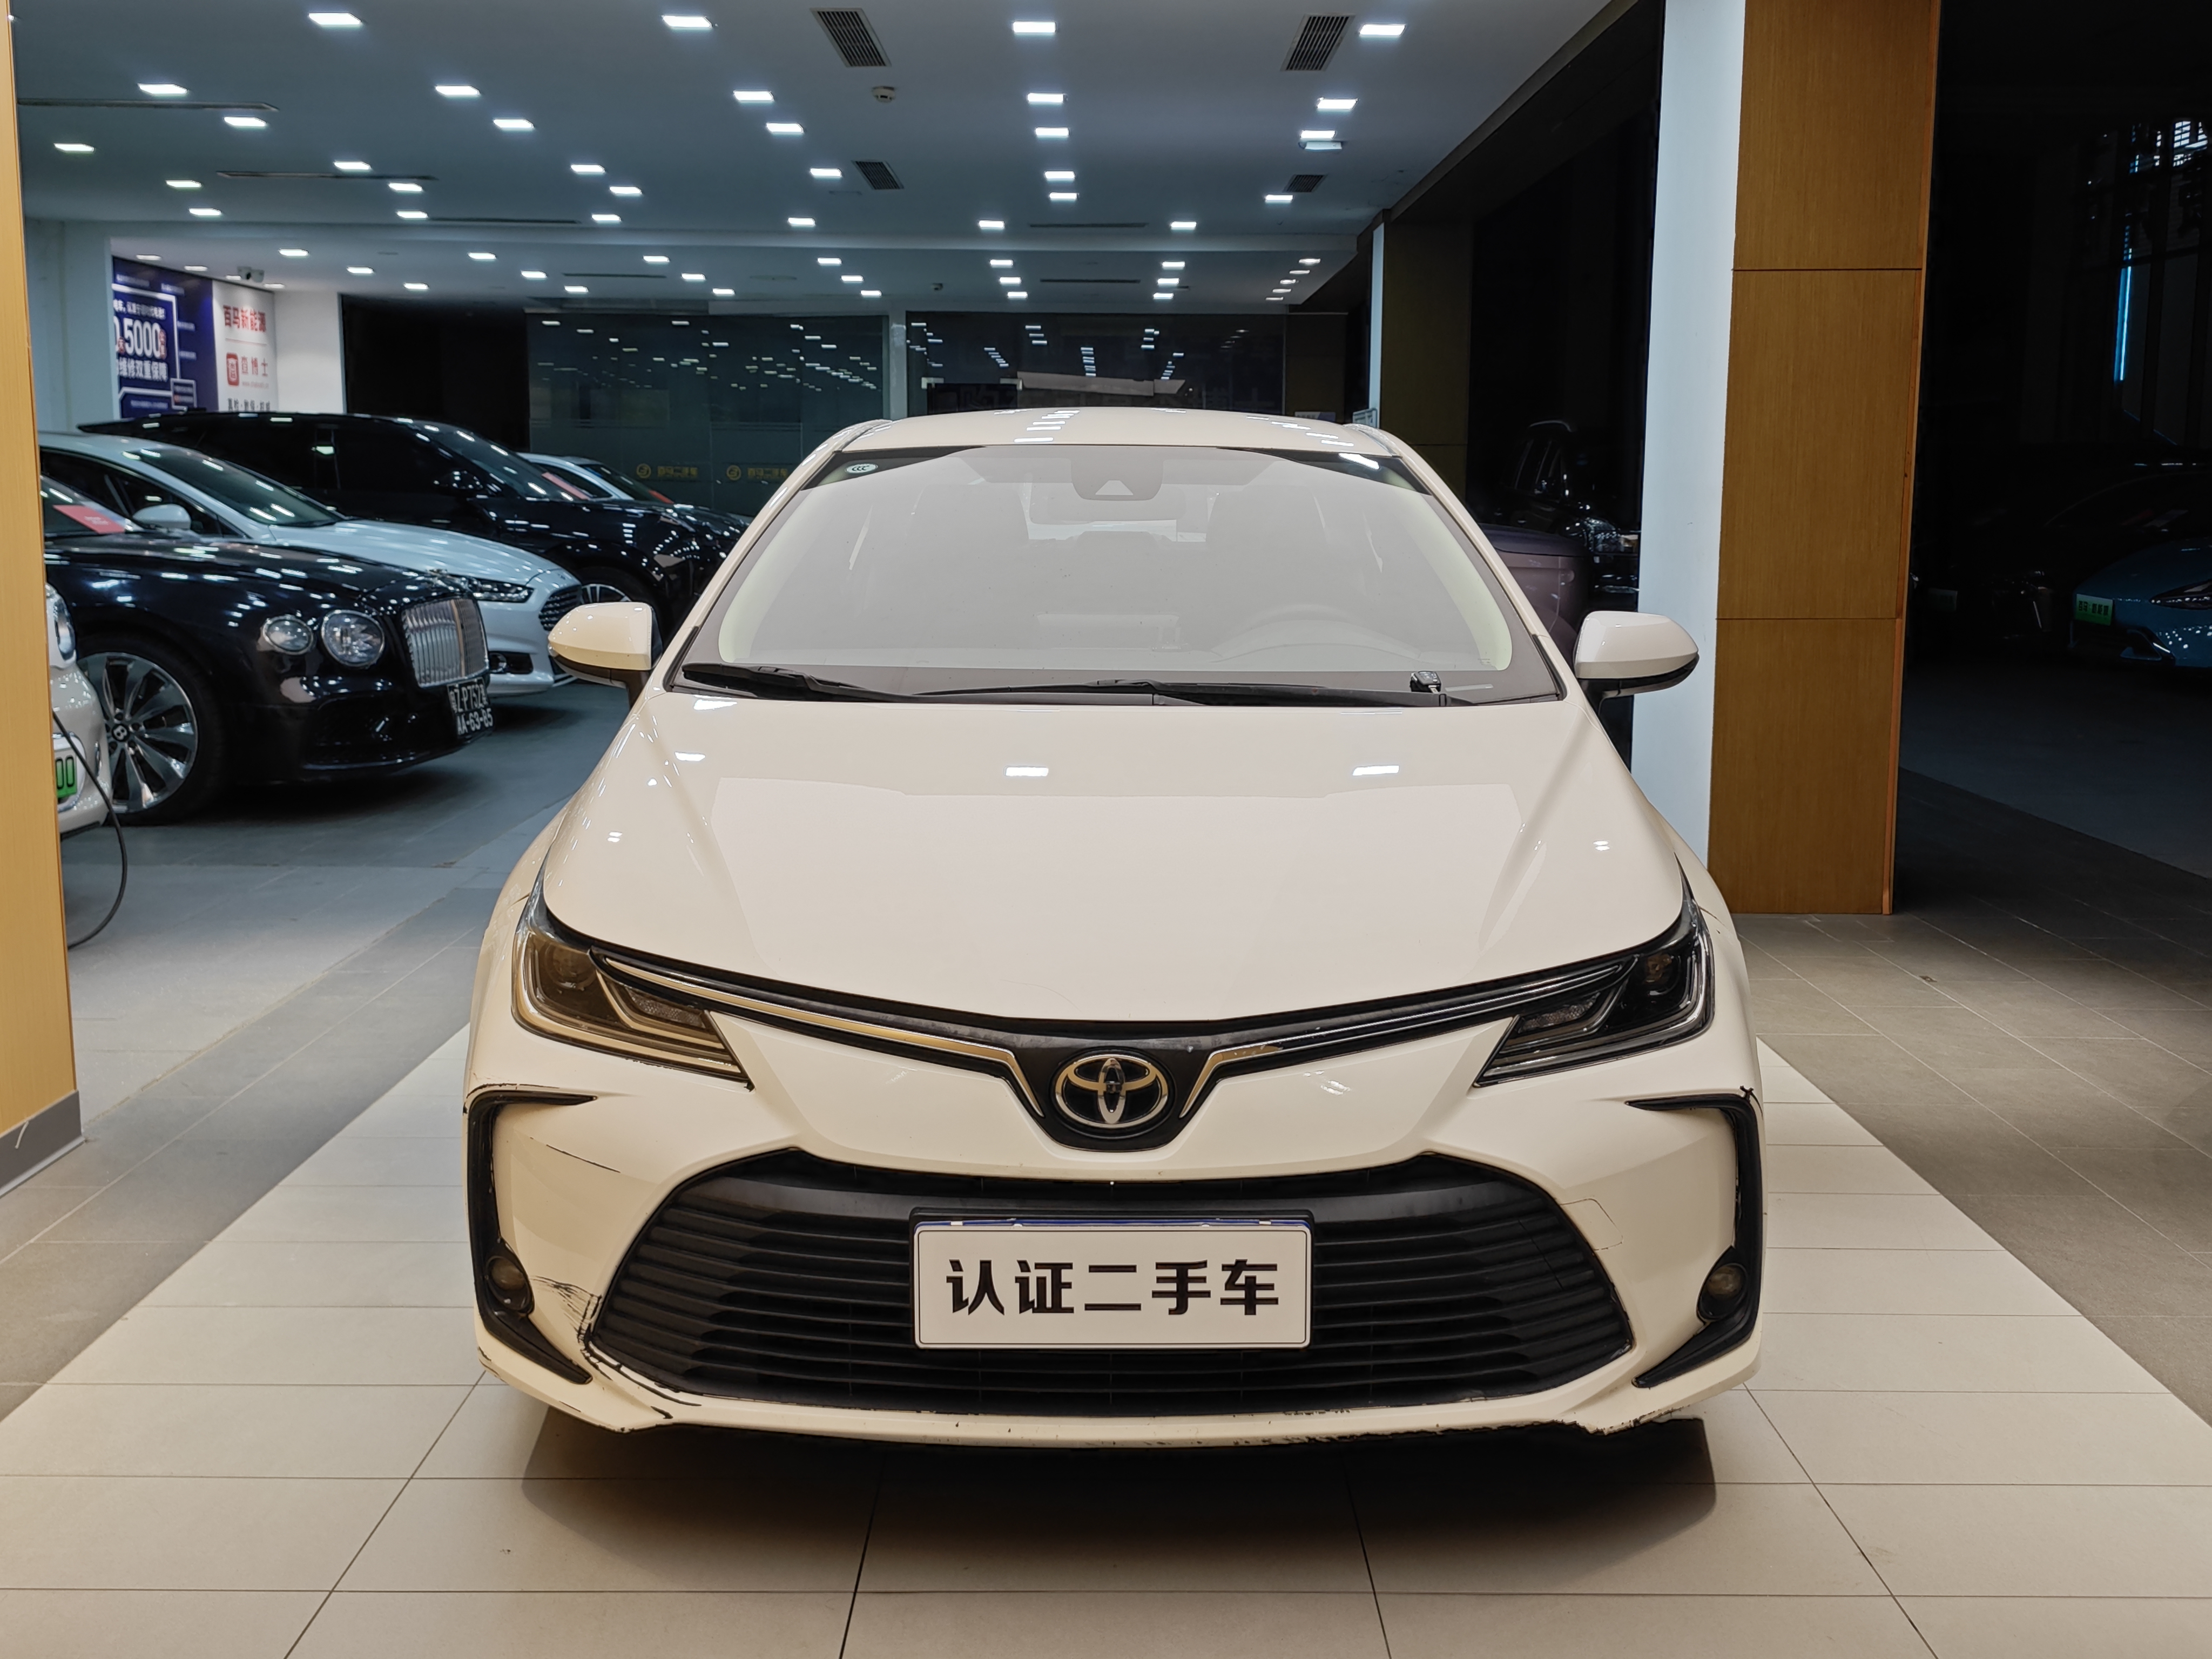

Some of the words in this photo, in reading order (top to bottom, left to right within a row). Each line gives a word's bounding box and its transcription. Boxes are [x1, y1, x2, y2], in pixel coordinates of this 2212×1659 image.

[946, 1259, 1279, 1316] 认证二手车
